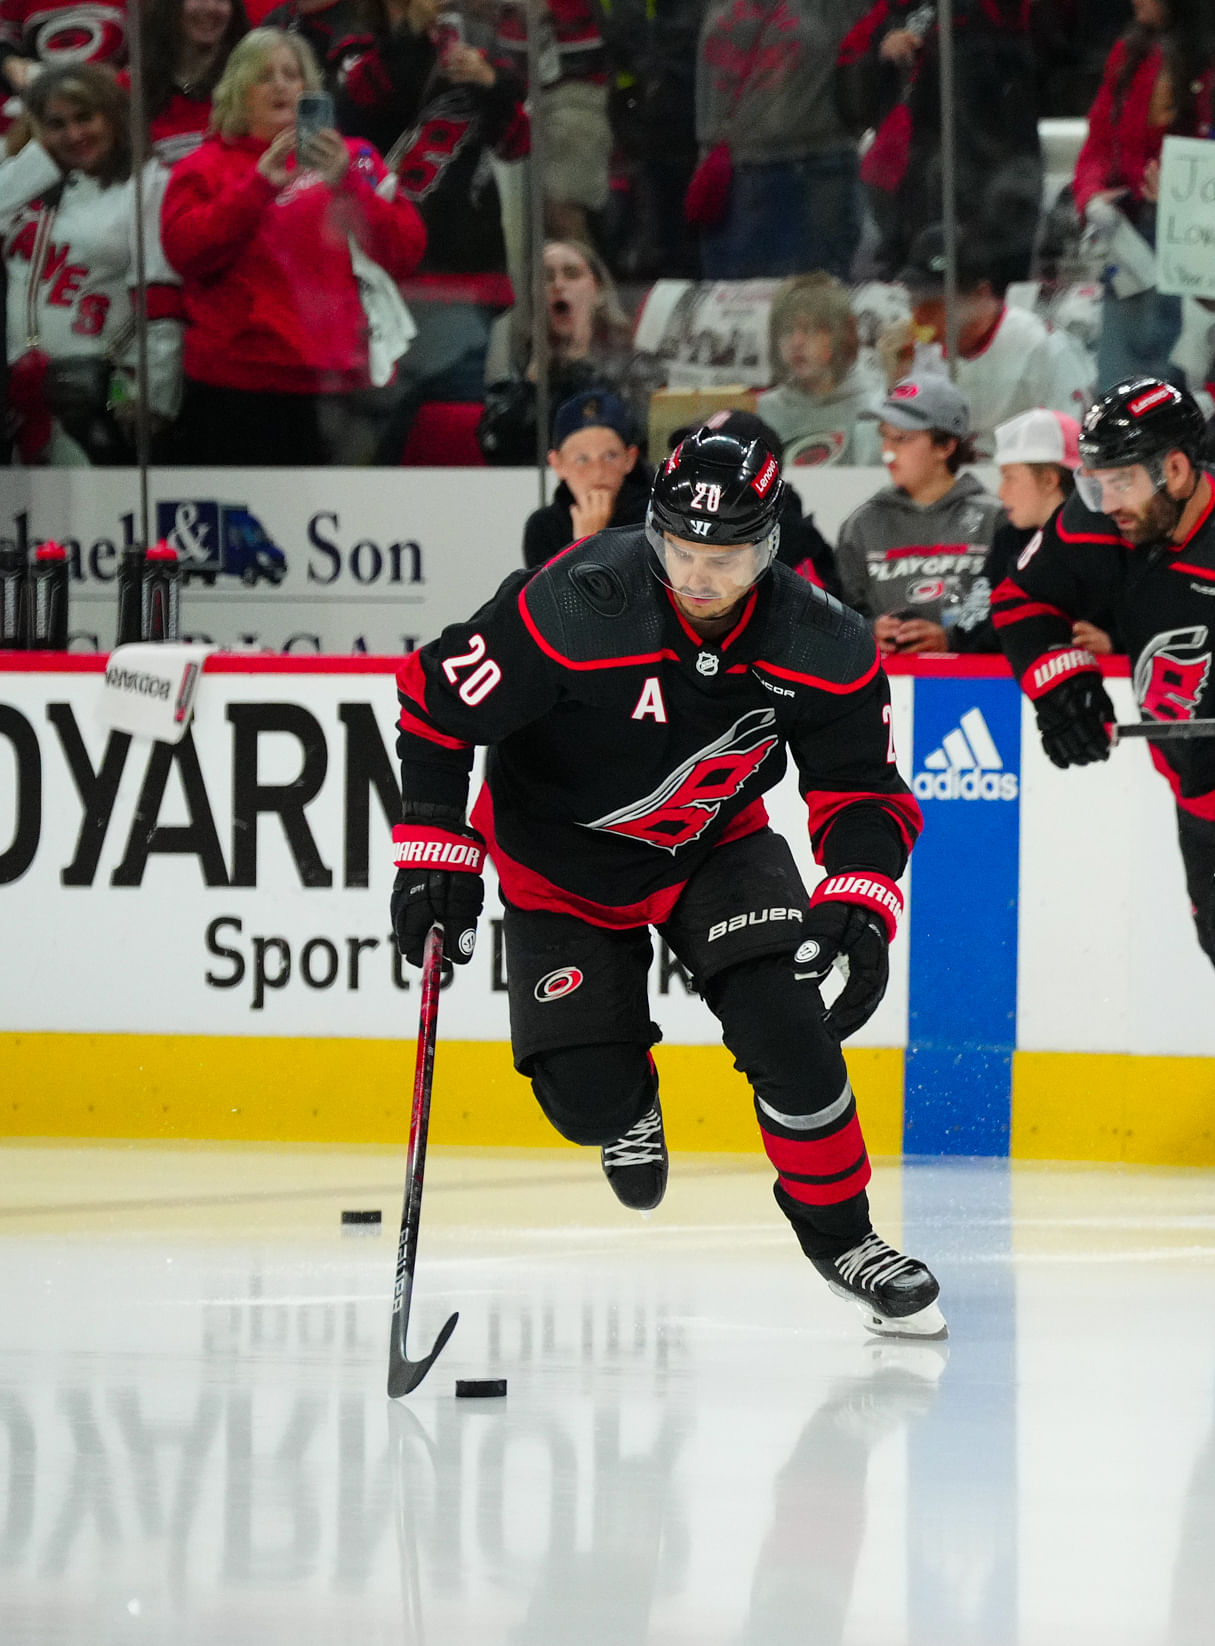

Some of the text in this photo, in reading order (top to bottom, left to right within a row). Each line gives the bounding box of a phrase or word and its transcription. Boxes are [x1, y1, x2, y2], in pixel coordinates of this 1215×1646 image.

[8, 220, 112, 337] ANES
[755, 459, 777, 493] Lenovo
[690, 482, 721, 513] 20
[306, 511, 425, 585] Son
[441, 632, 503, 708] 20
[752, 669, 796, 698] COR
[630, 676, 669, 724] A
[882, 704, 897, 765] 2
[912, 765, 1019, 801] adidas
[707, 907, 804, 942] BAUER
